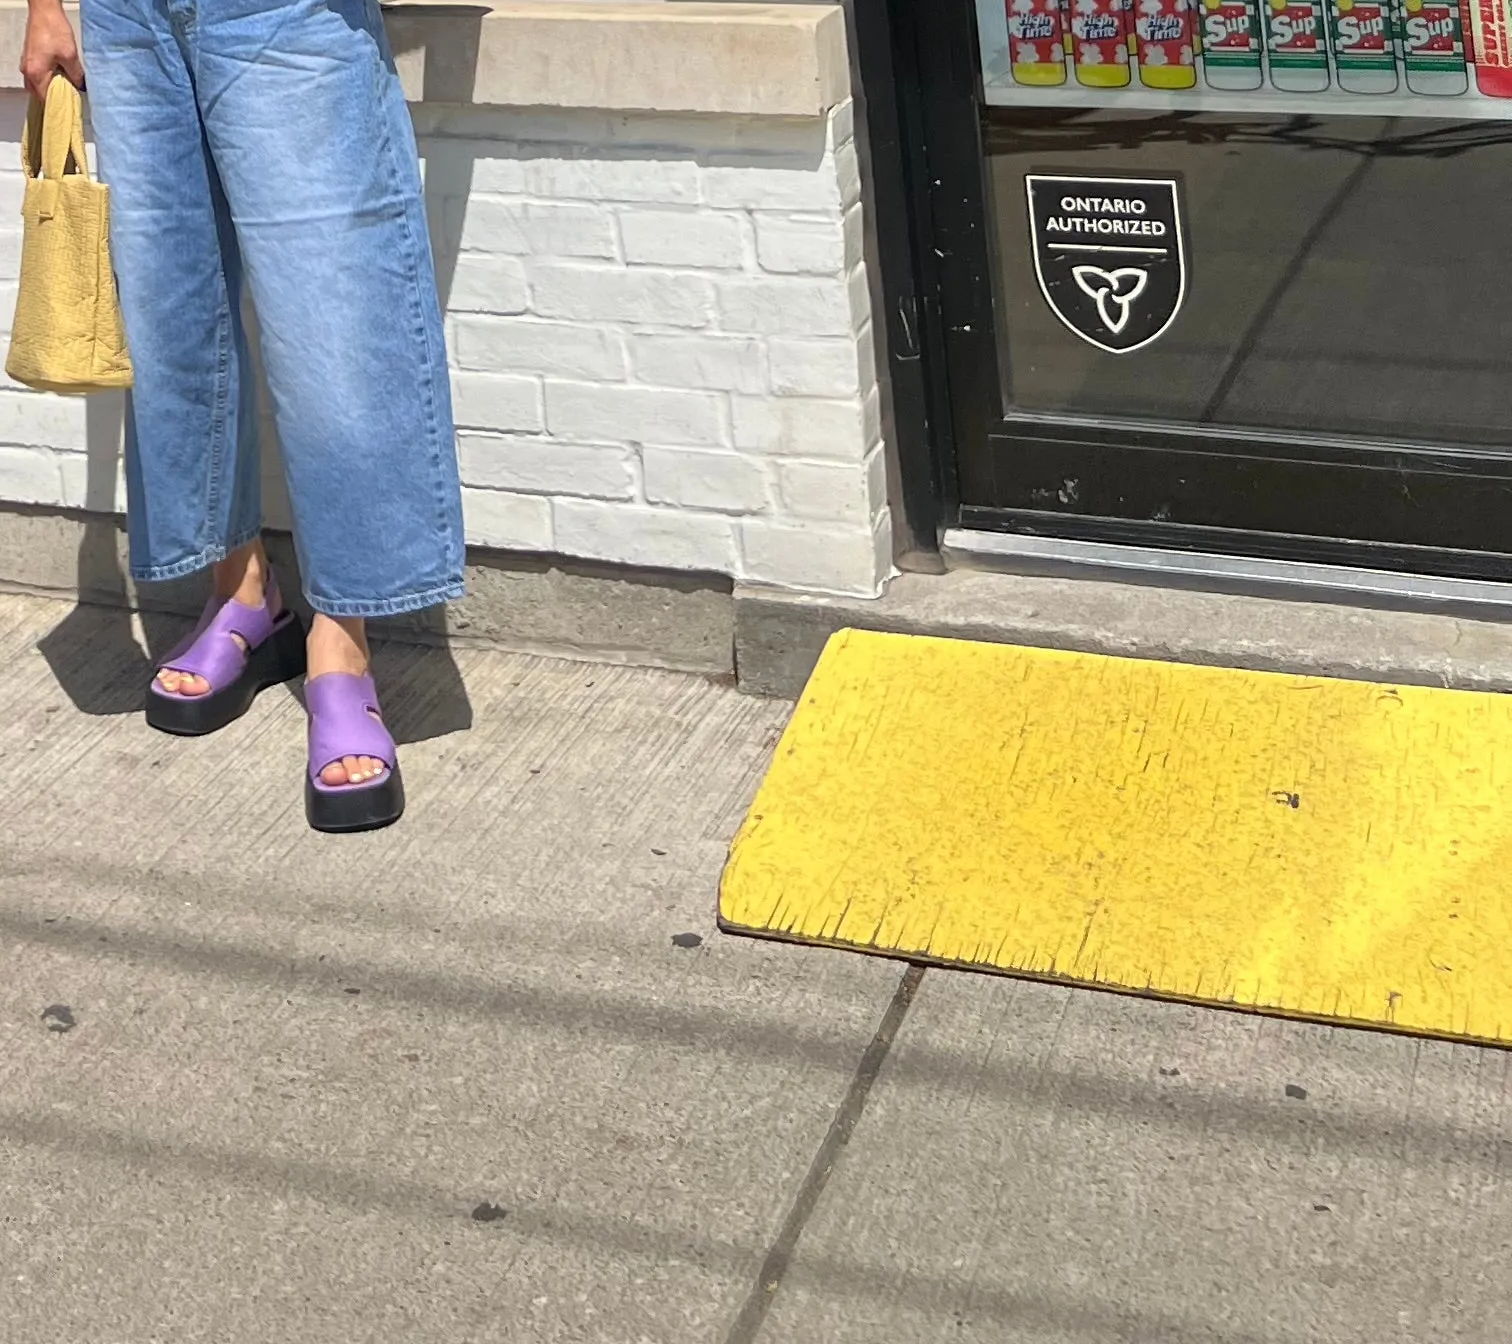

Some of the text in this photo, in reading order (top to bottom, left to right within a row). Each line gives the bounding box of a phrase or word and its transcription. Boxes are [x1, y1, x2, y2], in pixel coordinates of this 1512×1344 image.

[1018, 12, 1054, 29] High
[1081, 11, 1118, 29] High
[1146, 11, 1183, 29] High
[1204, 9, 1250, 43] Sup
[1270, 9, 1317, 43] Sup
[1336, 9, 1384, 44] Sup
[1404, 12, 1455, 45] Sup
[1018, 23, 1053, 40] Time
[1082, 22, 1117, 41] Time
[1145, 22, 1183, 40] Time
[1060, 196, 1147, 215] ONTARIO
[1045, 216, 1166, 237] AUTHORIZED
